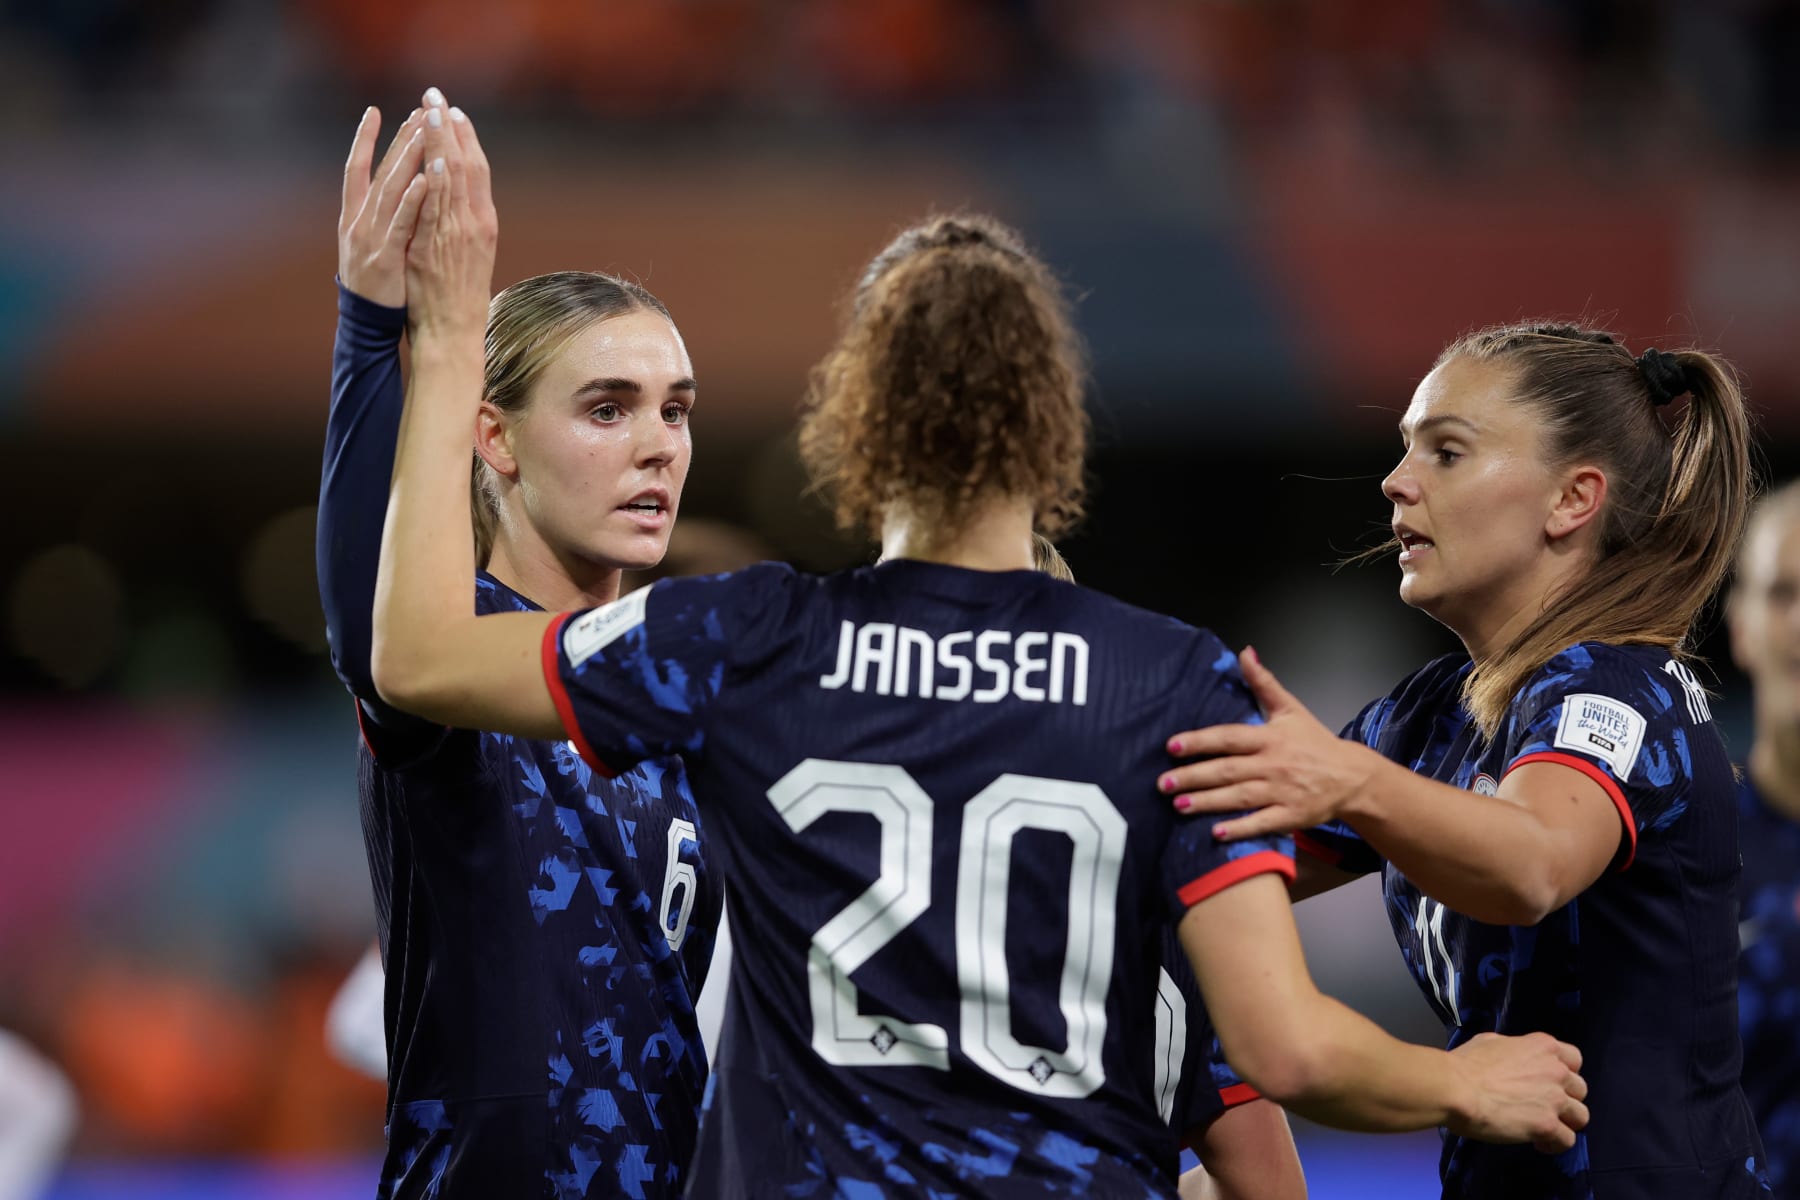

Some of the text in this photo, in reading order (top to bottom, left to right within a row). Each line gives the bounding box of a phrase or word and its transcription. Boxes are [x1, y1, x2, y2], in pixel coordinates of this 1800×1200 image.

[819, 620, 1090, 706] JANSSEN
[1577, 719, 1629, 750] the World
[1582, 707, 1629, 737] UNITES
[1584, 700, 1630, 725] FOOTBALL
[659, 817, 697, 952] 6
[766, 758, 1129, 1099] 20
[1415, 896, 1462, 1027] 11
